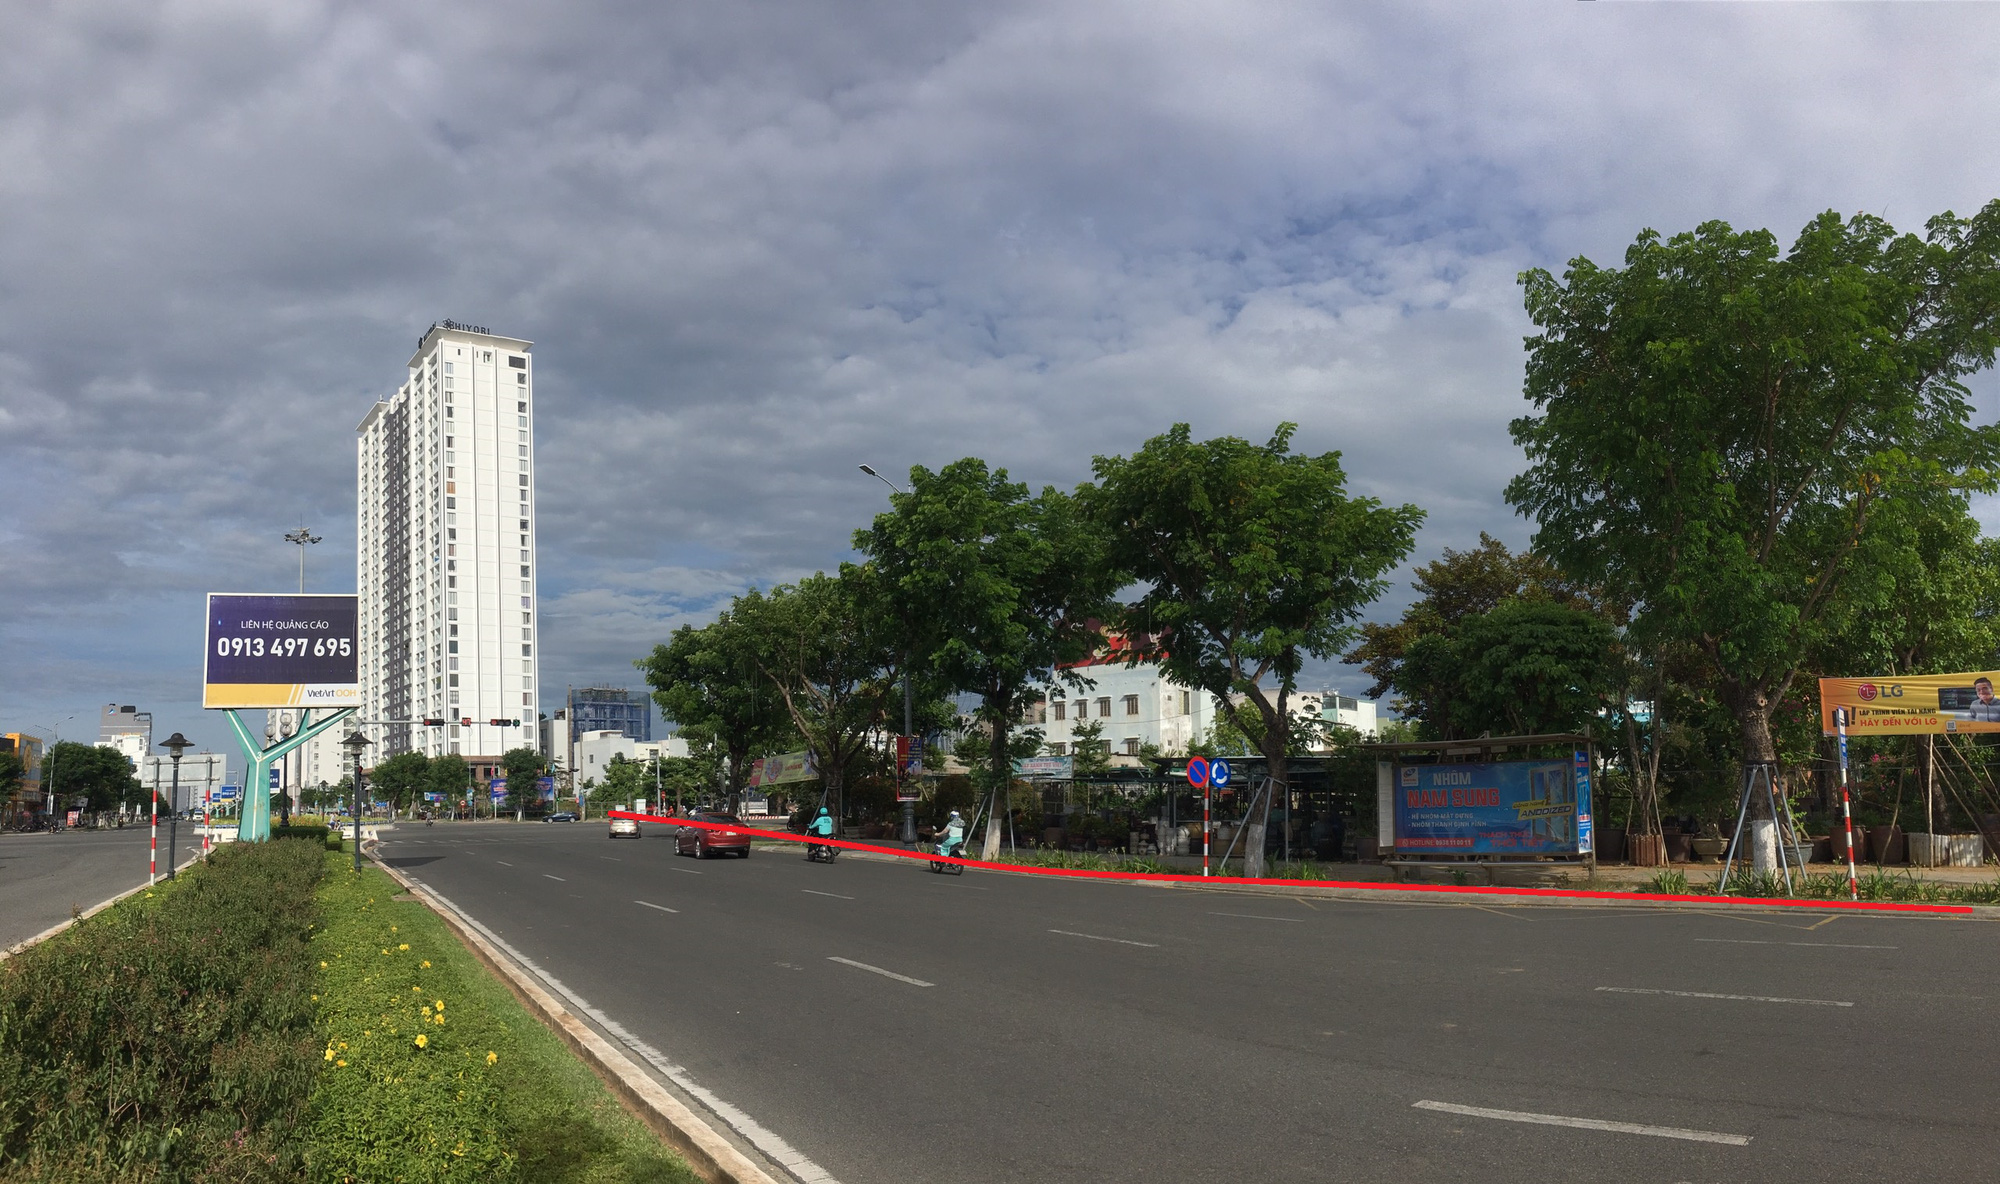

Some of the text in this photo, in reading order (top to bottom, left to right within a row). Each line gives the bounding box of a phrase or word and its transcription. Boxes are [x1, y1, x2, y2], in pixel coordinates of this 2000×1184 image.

[454, 322, 490, 335] HIYORI
[240, 619, 329, 631] LIÊN HỆ QUẢNG CÁO
[217, 637, 351, 657] 0913 497 695
[335, 689, 357, 697] OOH
[1881, 684, 1903, 698] LG
[1860, 717, 1879, 727] HÃY
[1883, 716, 1901, 726] ĐẾN
[1904, 716, 1922, 726] VỚI
[1925, 717, 1937, 726] LG
[256, 751, 262, 760] 3
[1432, 770, 1472, 786] NHÔM
[1407, 787, 1500, 809] NAM SUNG
